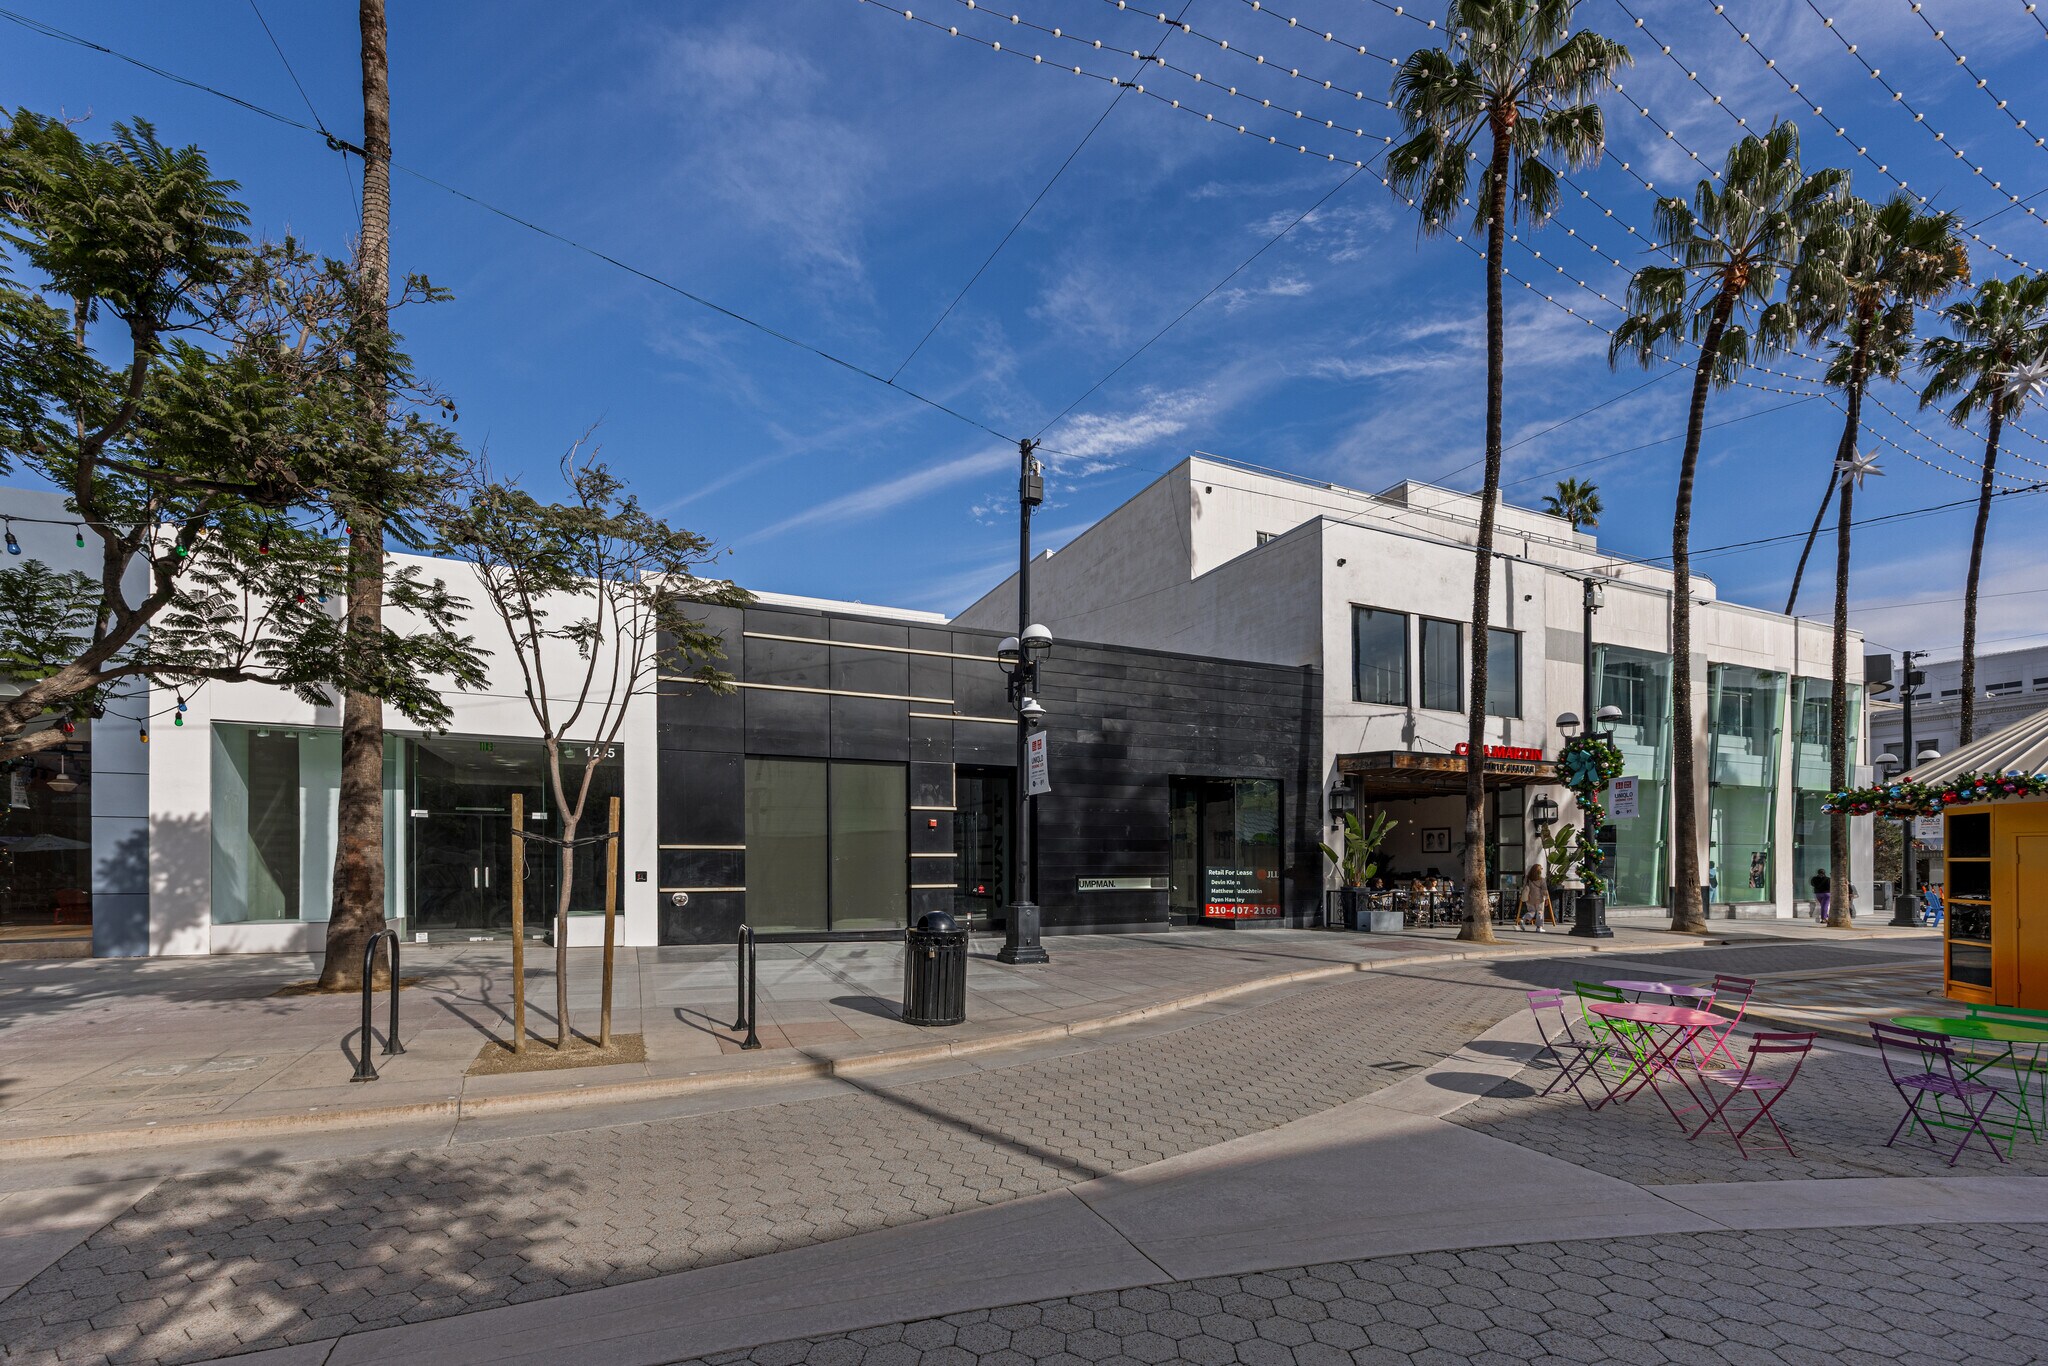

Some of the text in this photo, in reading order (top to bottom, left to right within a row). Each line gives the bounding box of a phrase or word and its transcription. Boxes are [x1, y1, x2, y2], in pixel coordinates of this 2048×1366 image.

[585, 746, 615, 758] 125
[1491, 745, 1543, 761] MARTIN
[1614, 791, 1633, 799] UNIQLO
[994, 794, 1003, 908] OWN IT
[1266, 870, 1279, 878] JLL
[1208, 906, 1278, 915] 310-407-2160
